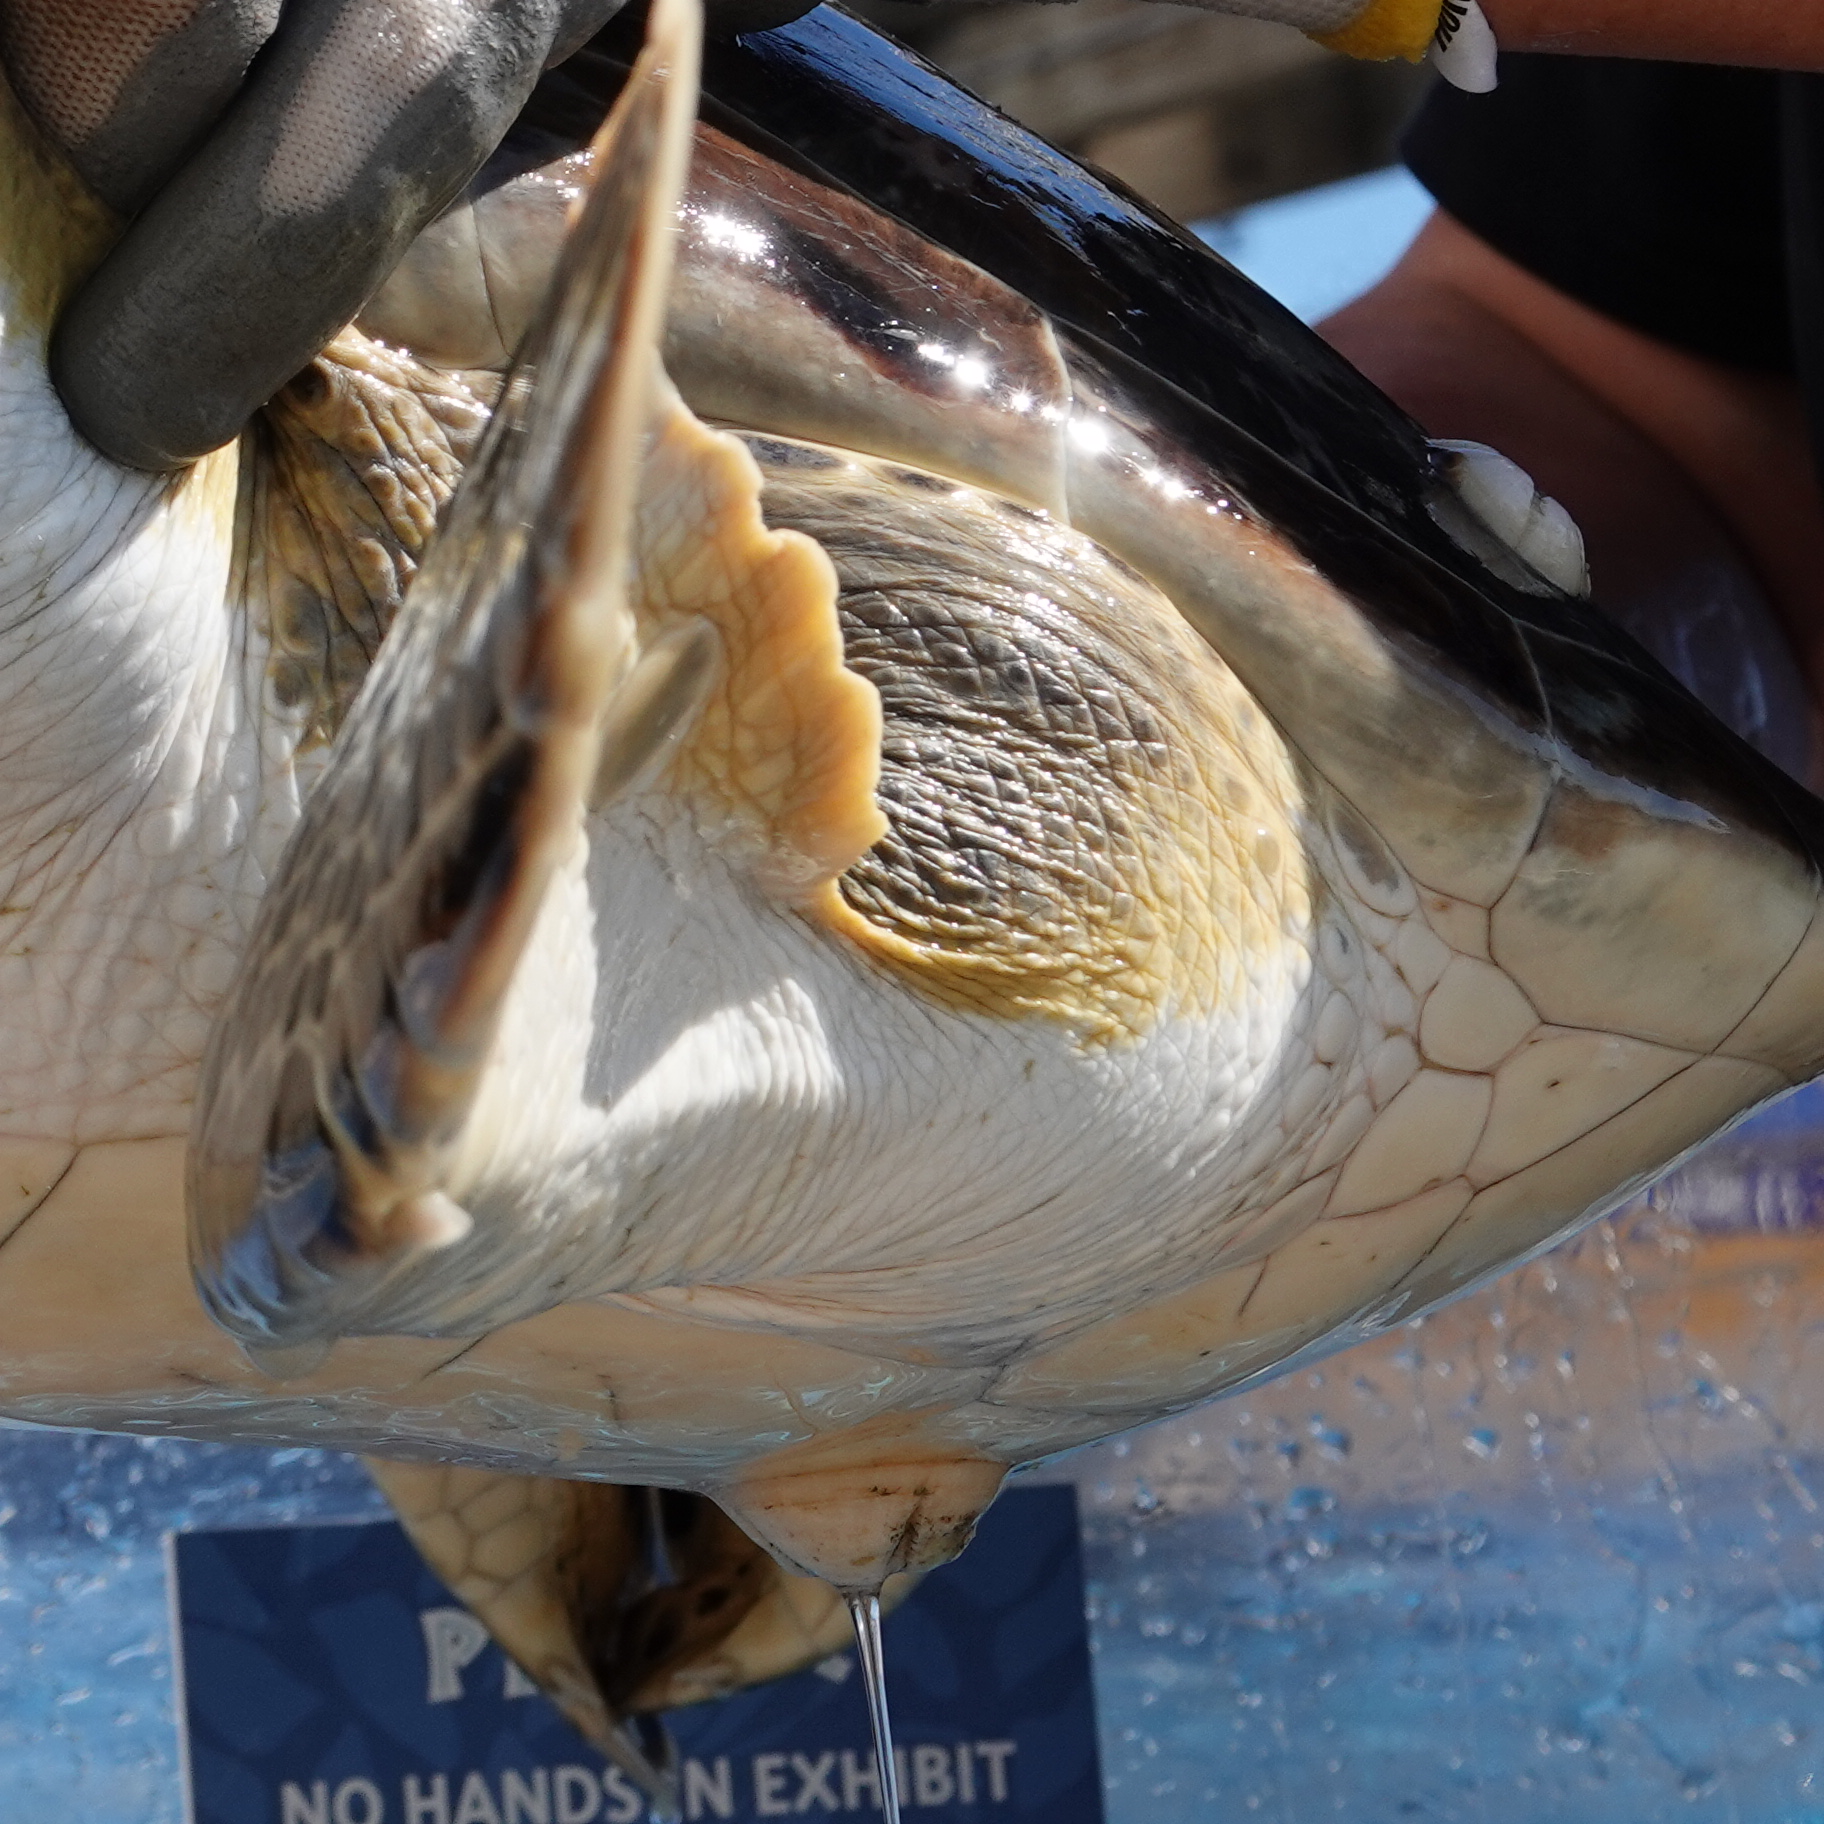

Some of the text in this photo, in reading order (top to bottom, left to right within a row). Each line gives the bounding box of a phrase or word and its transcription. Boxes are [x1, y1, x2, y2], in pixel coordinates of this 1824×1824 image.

[279, 1738, 1017, 1824] NO HANDS N EXHIBIT
